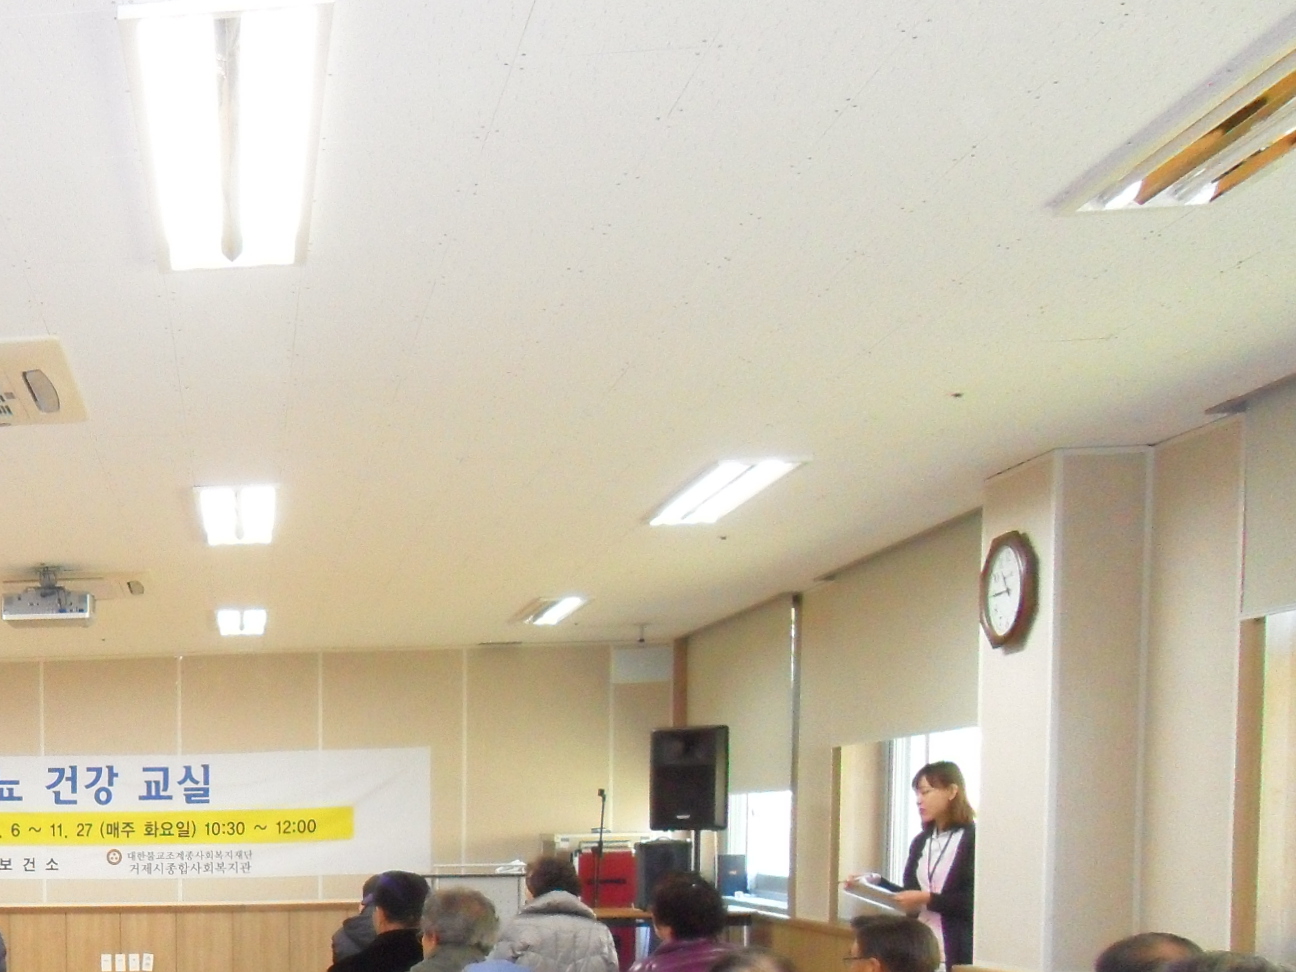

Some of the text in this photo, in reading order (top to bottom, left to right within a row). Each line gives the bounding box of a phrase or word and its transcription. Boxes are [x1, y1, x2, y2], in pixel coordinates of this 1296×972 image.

[45, 764, 119, 806] 건강
[138, 763, 210, 805] 교실
[11, 823, 20, 837] 6
[50, 823, 68, 838] 11.
[76, 821, 93, 837] 27
[100, 820, 135, 839] (매주
[143, 819, 197, 838] 화요일)
[204, 821, 245, 836] 10:30
[276, 819, 317, 835] 12:00
[129, 861, 251, 875] 거제시종합사회복지관
